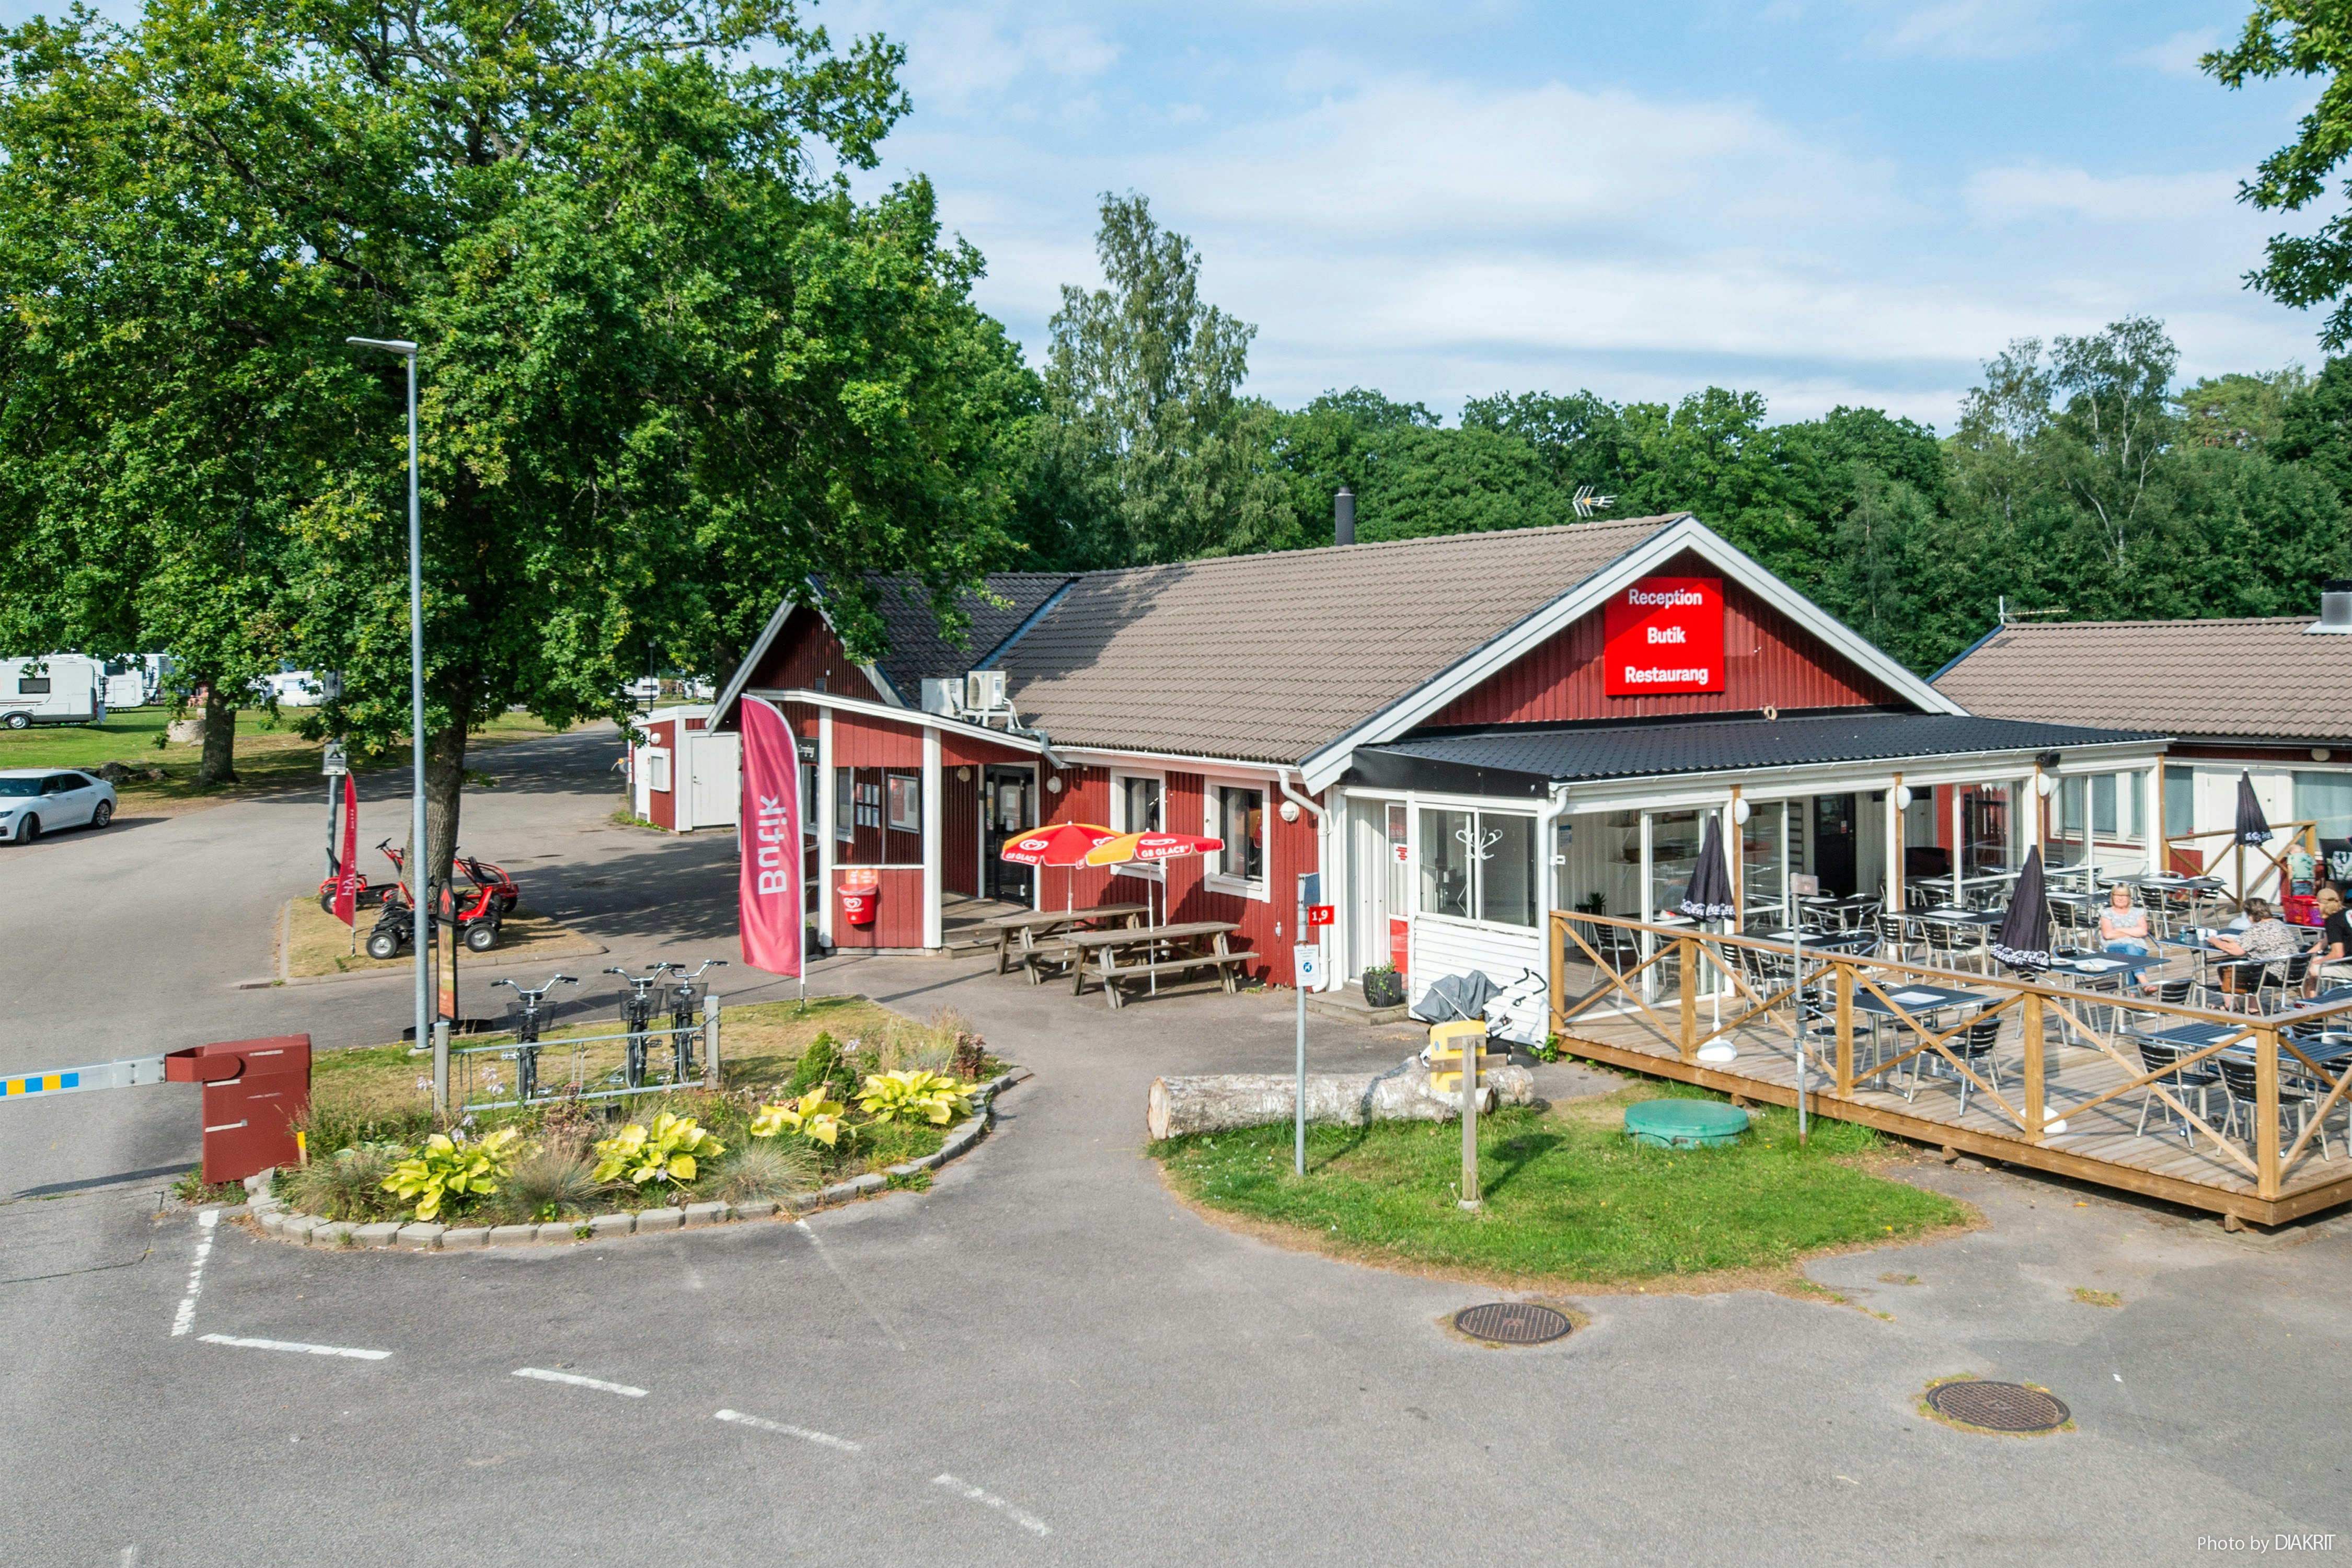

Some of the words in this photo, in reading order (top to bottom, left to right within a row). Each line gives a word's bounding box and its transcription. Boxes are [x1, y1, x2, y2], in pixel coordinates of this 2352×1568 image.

[1629, 589, 1702, 609] Reception
[1647, 626, 1686, 643] Butik
[1625, 666, 1708, 685] Restaurang
[758, 795, 788, 895] Butik
[1141, 849, 1154, 858] GB
[1312, 909, 1328, 923] 1,9
